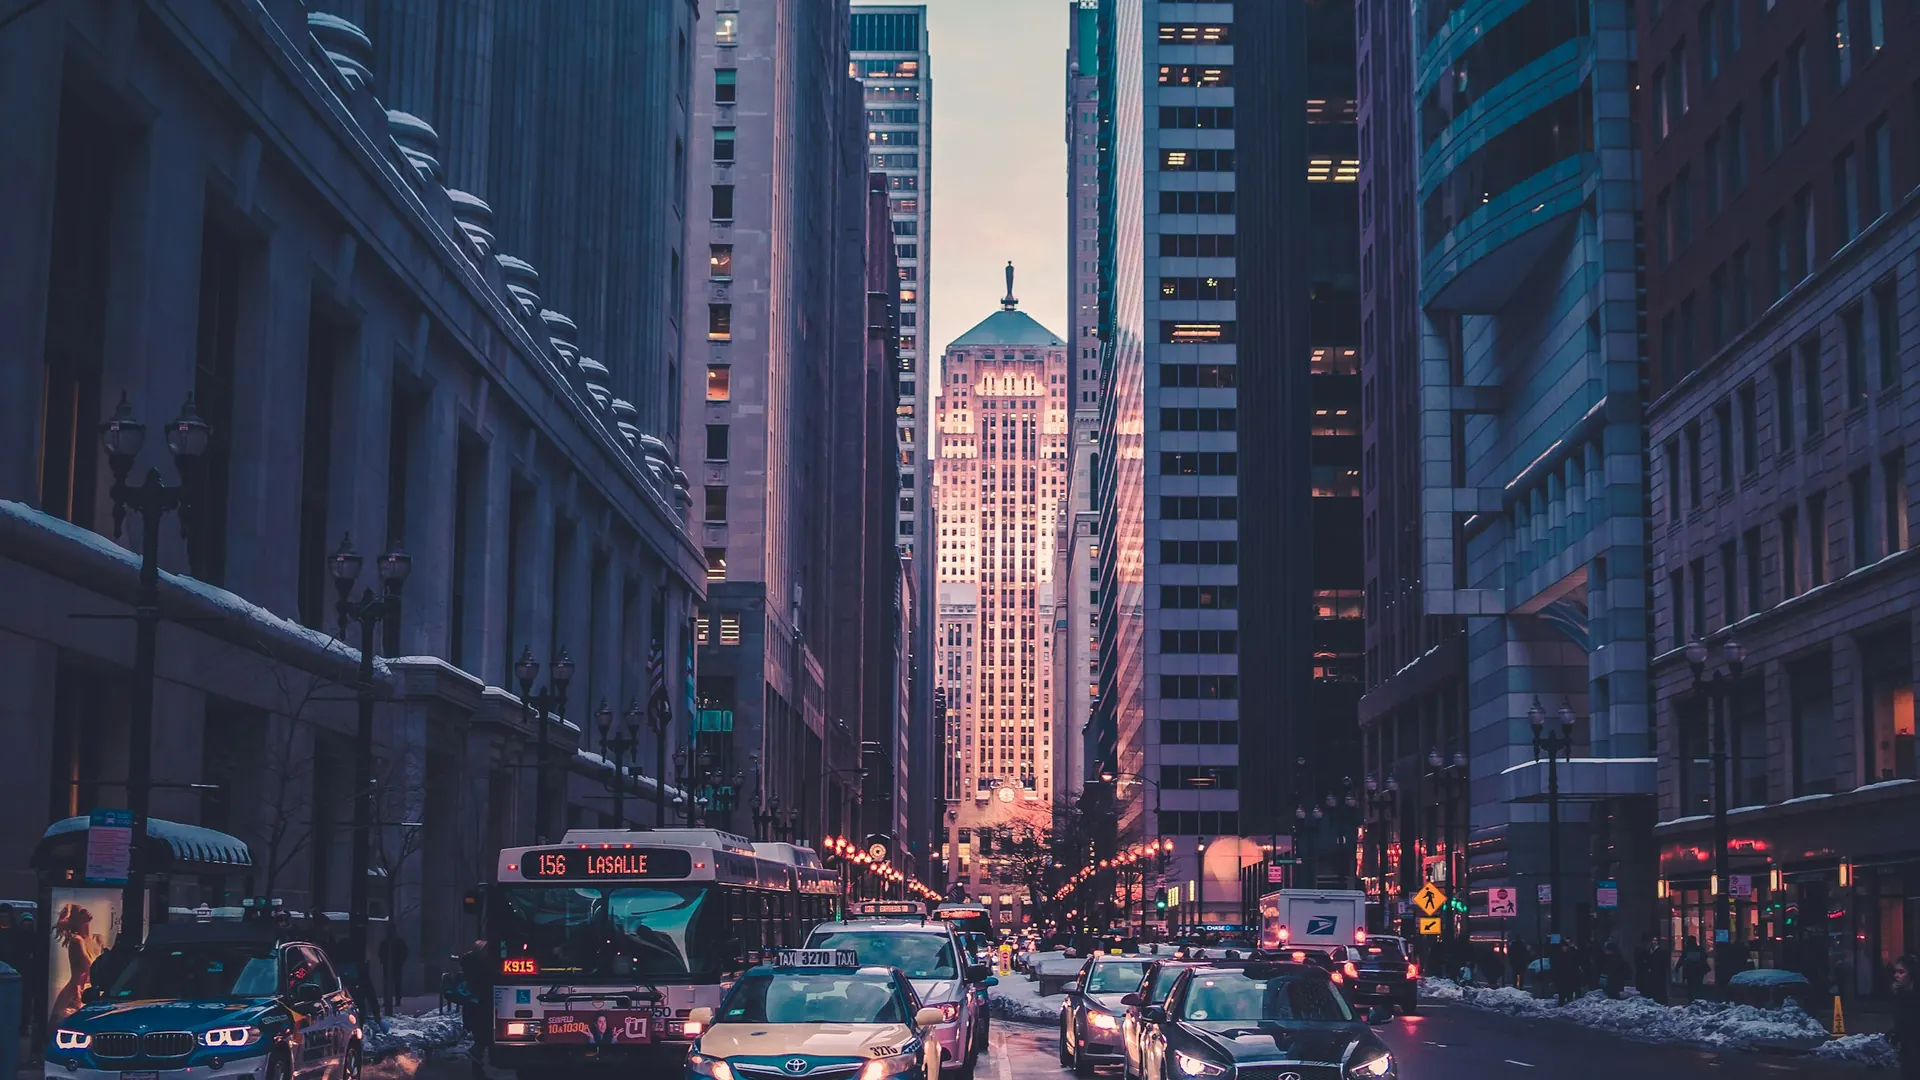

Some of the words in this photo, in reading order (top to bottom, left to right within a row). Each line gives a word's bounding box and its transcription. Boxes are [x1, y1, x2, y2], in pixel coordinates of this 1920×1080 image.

[539, 854, 566, 875] 156
[588, 855, 648, 874] LASALLE
[778, 952, 797, 966] TAXI
[801, 951, 830, 965] 3270
[836, 952, 855, 966] TAXI
[504, 960, 534, 973] K915
